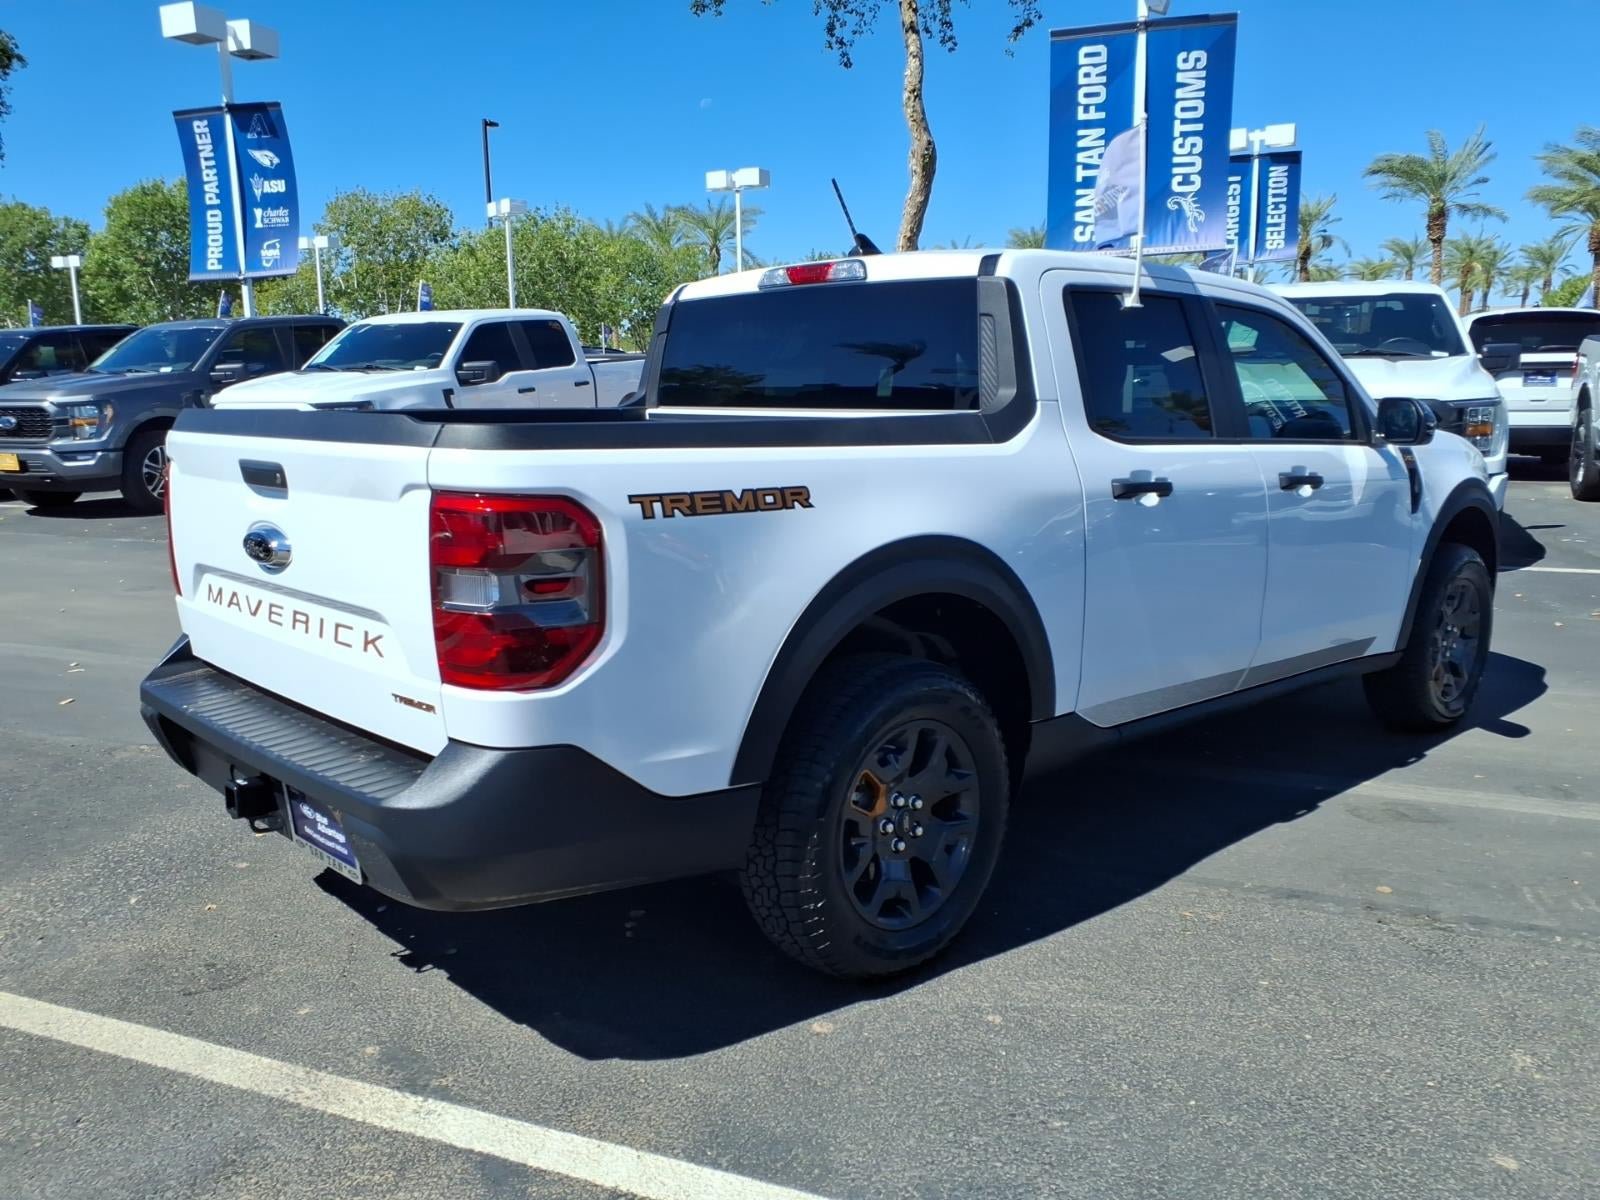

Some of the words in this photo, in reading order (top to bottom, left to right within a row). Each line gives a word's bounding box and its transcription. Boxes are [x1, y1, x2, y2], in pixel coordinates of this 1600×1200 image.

[1077, 44, 1107, 121] FORD
[1076, 127, 1106, 183] TAN
[1170, 49, 1208, 194] CUSTOMS
[192, 119, 221, 206] PARTNER
[263, 179, 286, 194] ASU
[206, 209, 224, 271] PROUD
[1073, 188, 1097, 243] SAN
[1265, 165, 1289, 250] SELECTION
[627, 485, 816, 520] TREMOR
[207, 583, 385, 659] MAVERICK
